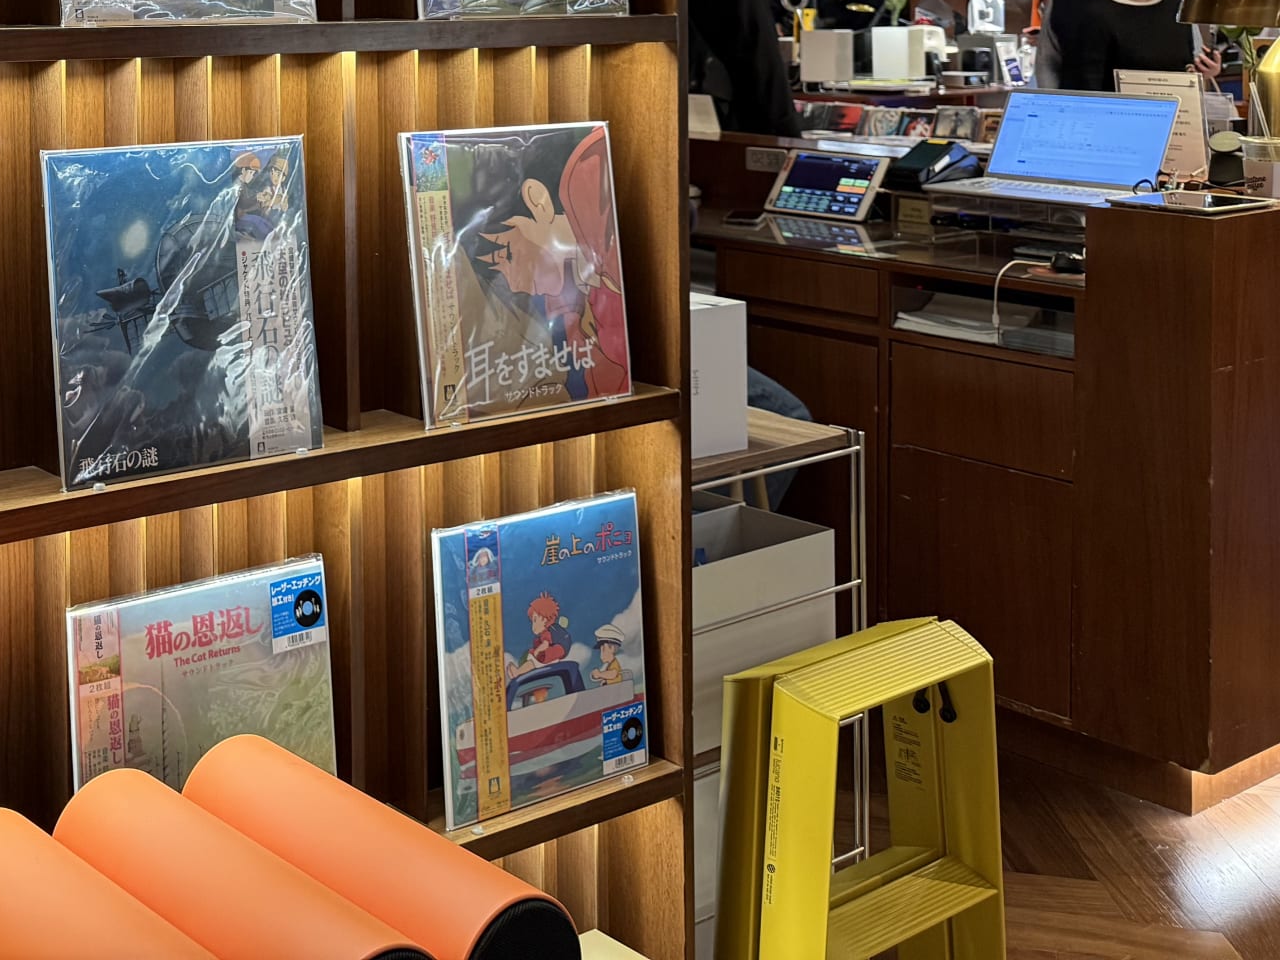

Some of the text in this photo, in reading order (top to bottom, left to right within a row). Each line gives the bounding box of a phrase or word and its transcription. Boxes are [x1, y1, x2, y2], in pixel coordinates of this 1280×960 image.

[464, 337, 596, 403] 耳をすませば
[505, 384, 562, 402] サウンドトラック
[541, 521, 633, 566] 崖の上のポニョ
[597, 550, 632, 564] サウンドトラック
[271, 576, 321, 595] レーザーエッチング
[93, 614, 104, 659] 猫の恩返し
[144, 605, 265, 660] 猫の恩返し
[174, 645, 241, 668] The Cat Returns
[89, 681, 111, 694] 2枚組
[107, 693, 123, 765] 猫の恩返し
